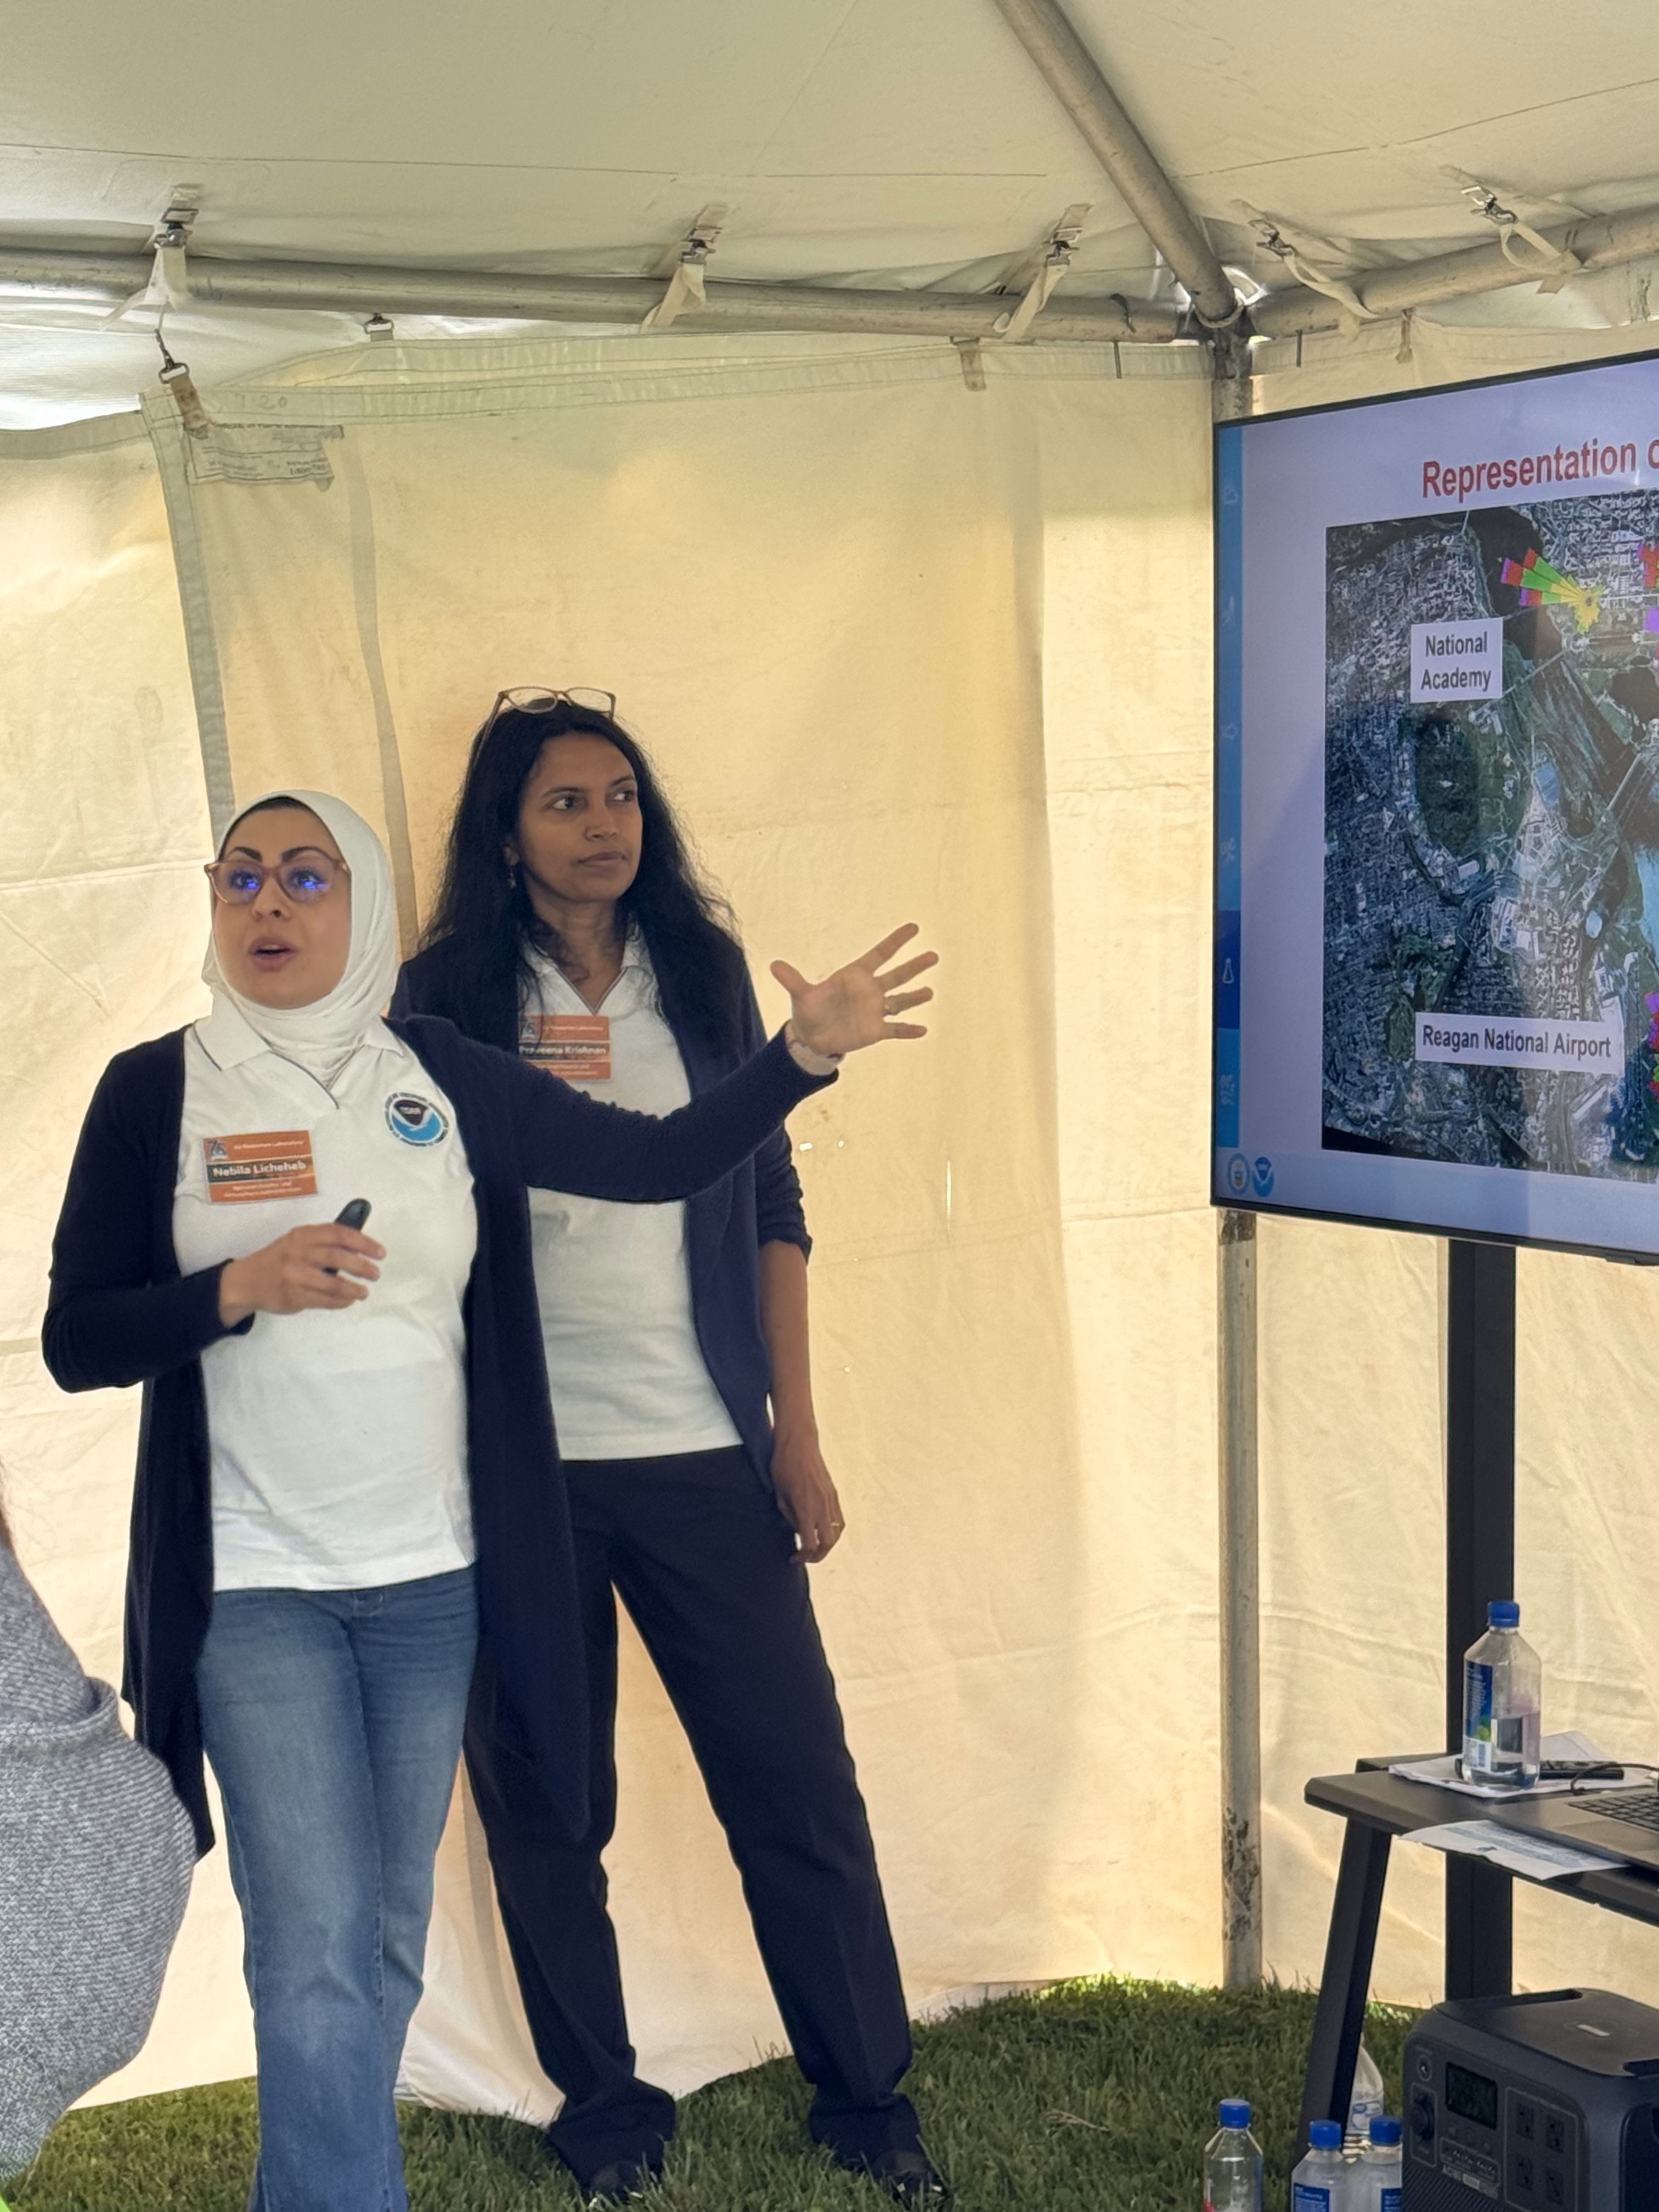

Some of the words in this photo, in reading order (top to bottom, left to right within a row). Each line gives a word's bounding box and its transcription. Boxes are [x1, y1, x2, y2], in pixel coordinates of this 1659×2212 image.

[1423, 438, 1636, 504] Representation
[1425, 631, 1488, 656] National
[1420, 668, 1492, 692] Academy
[1422, 1025, 1479, 1051] Reagan
[1483, 1028, 1549, 1054] National
[1553, 1033, 1611, 1061] Airport
[212, 1165, 251, 1177] Nebila
